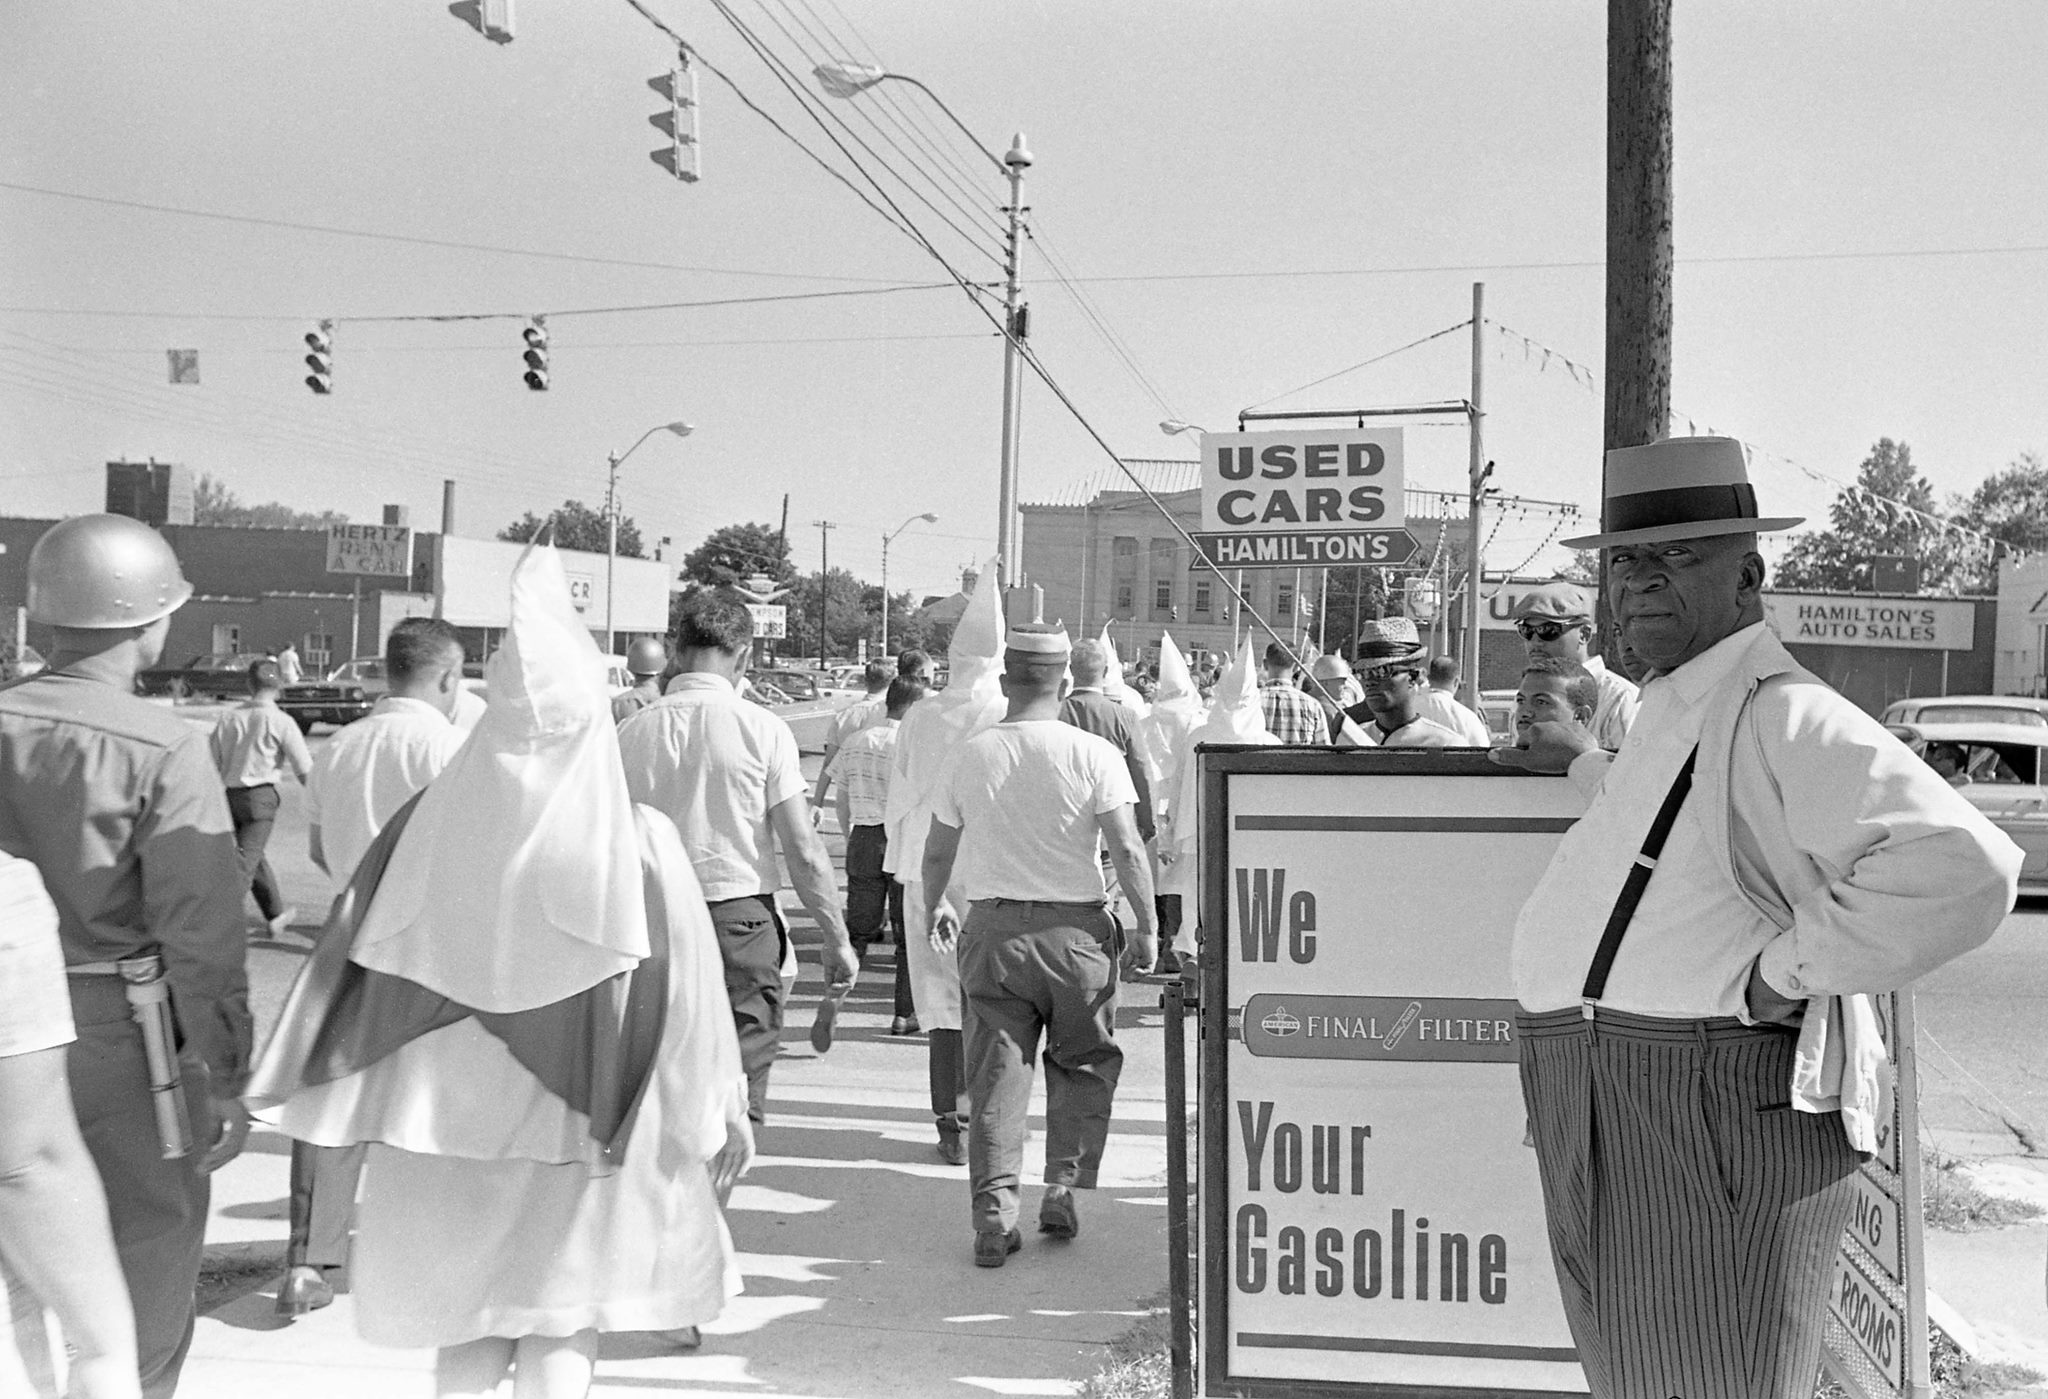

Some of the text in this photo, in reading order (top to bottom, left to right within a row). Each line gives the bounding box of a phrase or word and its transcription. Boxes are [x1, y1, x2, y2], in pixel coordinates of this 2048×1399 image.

[1218, 442, 1385, 480] USED
[1217, 485, 1385, 525] CARS
[333, 525, 407, 541] HERTZ
[1217, 533, 1389, 562] HAMILTON'S
[340, 541, 396, 556] RENT
[334, 556, 403, 574] A CAR
[1799, 606, 1936, 624] HAMILTON'S
[1799, 622, 1936, 641] AUTO SALES
[1235, 868, 1317, 965] We
[1307, 1016, 1384, 1040] FINAL
[1419, 1018, 1512, 1042] FILTER
[1236, 1100, 1371, 1196] Your
[1235, 1202, 1508, 1305] Gasoline
[1840, 1270, 1896, 1369] ROOMS
